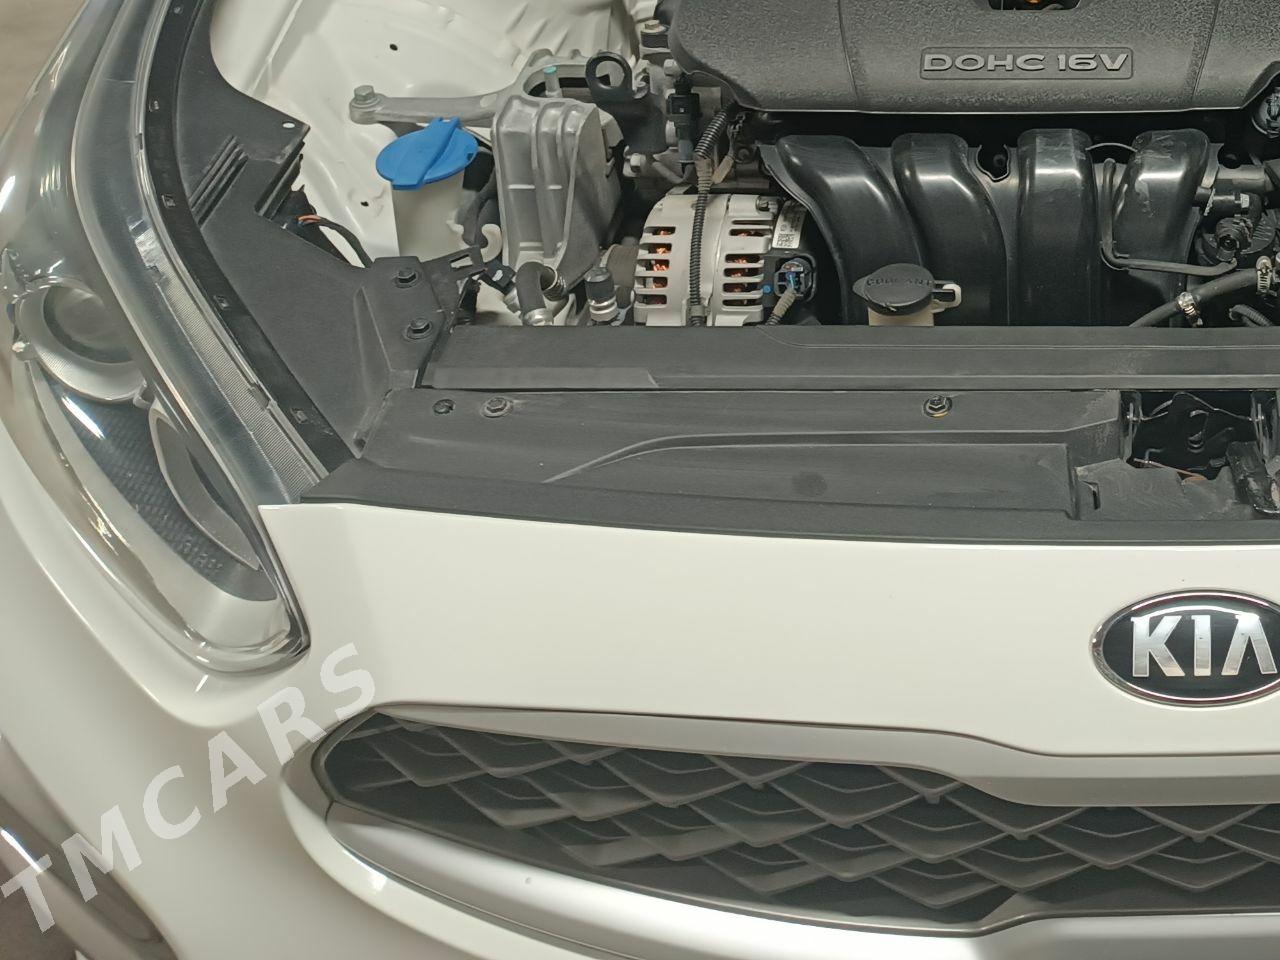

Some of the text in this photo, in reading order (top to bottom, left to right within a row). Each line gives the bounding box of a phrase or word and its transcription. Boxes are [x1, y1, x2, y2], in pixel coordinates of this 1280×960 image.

[923, 53, 1129, 72] DOHC 16V
[1130, 614, 1278, 678] KIA
